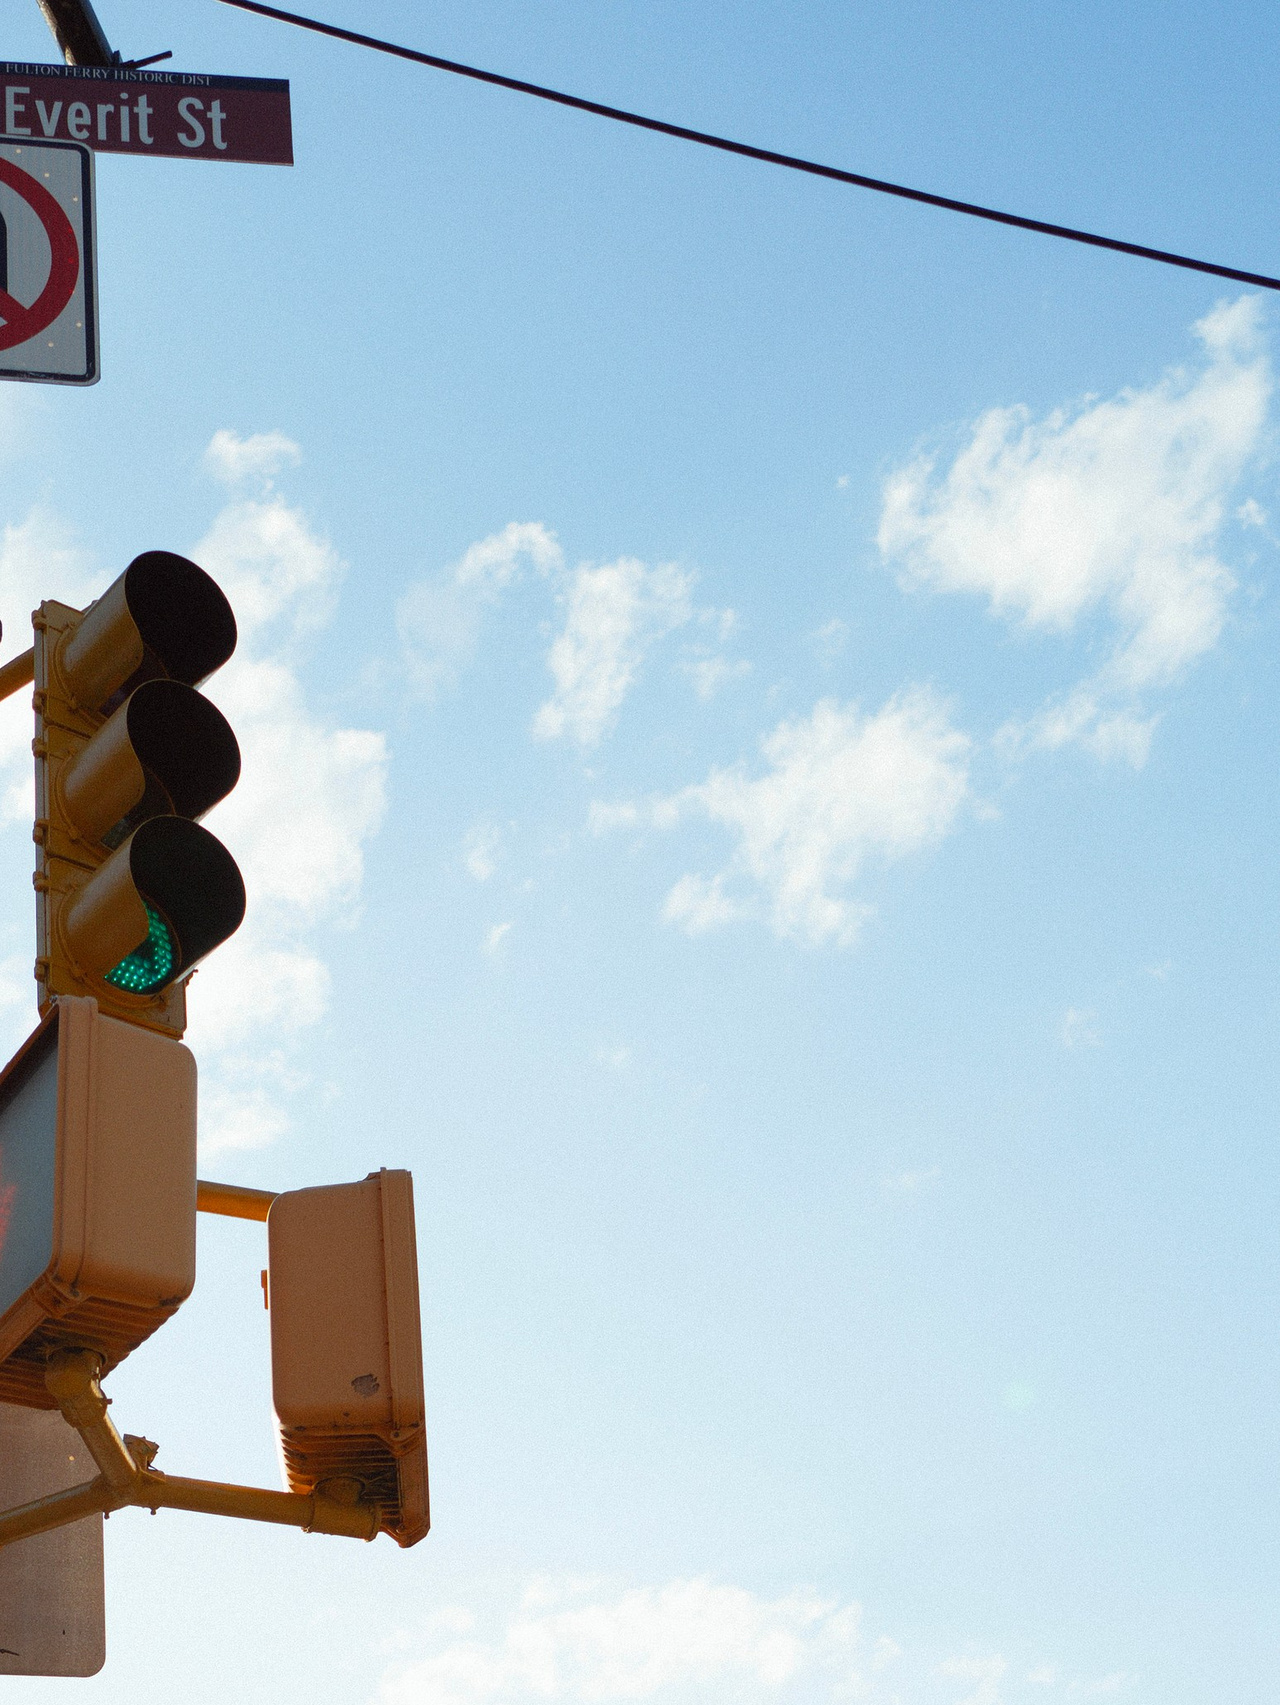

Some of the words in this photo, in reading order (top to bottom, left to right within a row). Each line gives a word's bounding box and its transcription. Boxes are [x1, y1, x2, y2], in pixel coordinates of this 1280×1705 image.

[6, 63, 60, 77] FULTON
[65, 66, 110, 80] FERRY
[114, 69, 177, 84] HISTORIC
[182, 74, 213, 87] DIST
[5, 86, 154, 145] Everit
[177, 97, 228, 150] St
